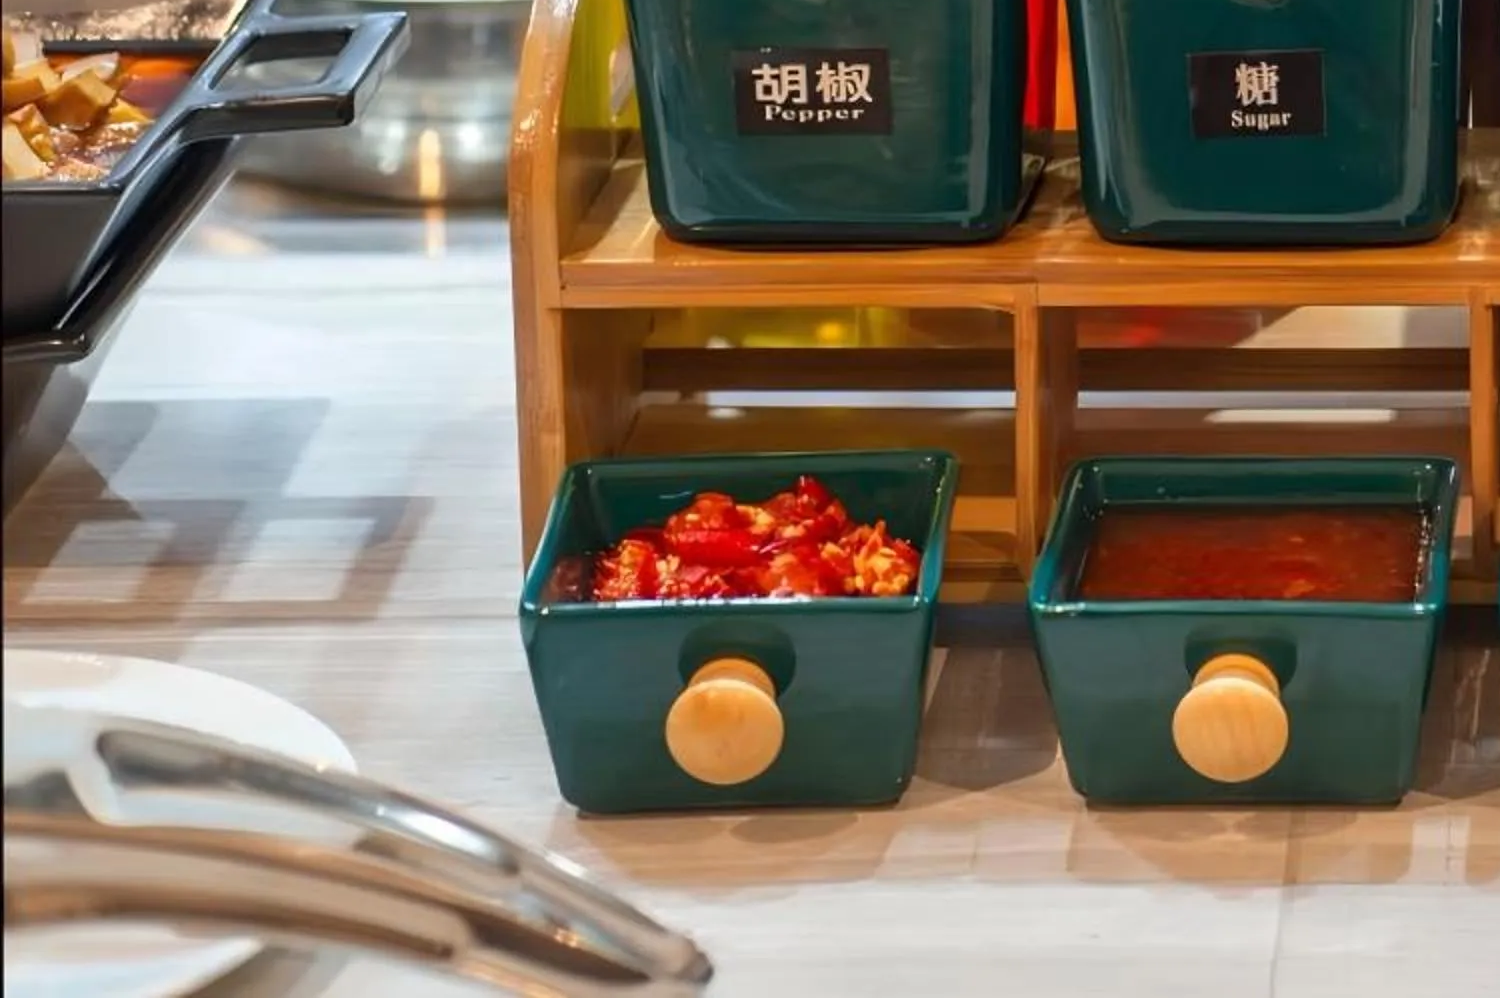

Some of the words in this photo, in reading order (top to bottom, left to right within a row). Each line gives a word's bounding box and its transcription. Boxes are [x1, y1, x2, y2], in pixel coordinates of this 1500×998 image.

[751, 61, 873, 104] 胡椒
[1235, 61, 1280, 106] 糖
[765, 104, 865, 122] Pepper
[1231, 109, 1292, 131] Sugar
